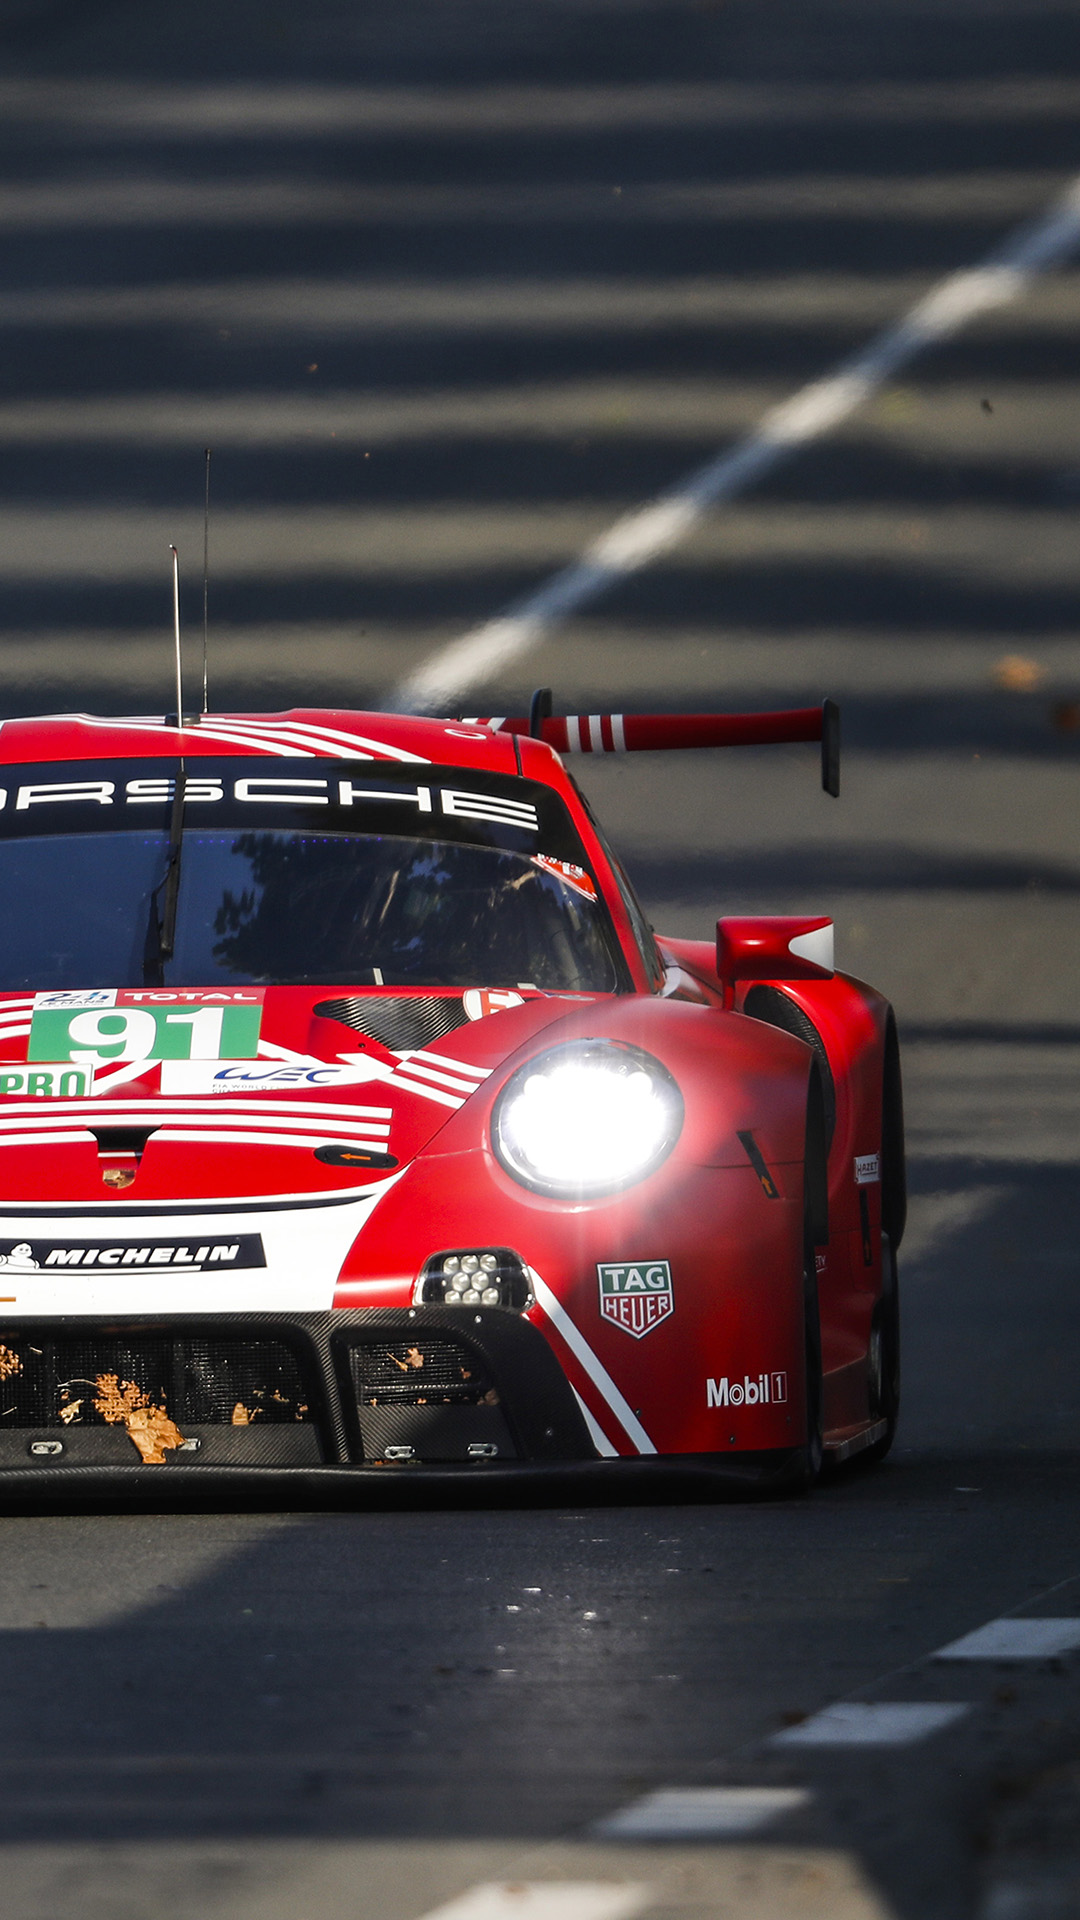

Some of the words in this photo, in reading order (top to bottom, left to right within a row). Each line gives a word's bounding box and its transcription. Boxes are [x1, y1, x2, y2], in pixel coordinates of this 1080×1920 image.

[0, 777, 539, 831] RSCHE
[124, 992, 258, 1001] TOTAL
[68, 1007, 225, 1061] 91
[0, 1070, 86, 1096] PRO
[213, 1066, 341, 1083] WEC
[856, 1161, 878, 1176] HAZET
[45, 1244, 240, 1265] MICHELIN
[604, 1266, 665, 1291] TAG
[605, 1295, 669, 1332] HEUER
[706, 1373, 769, 1408] Mobil
